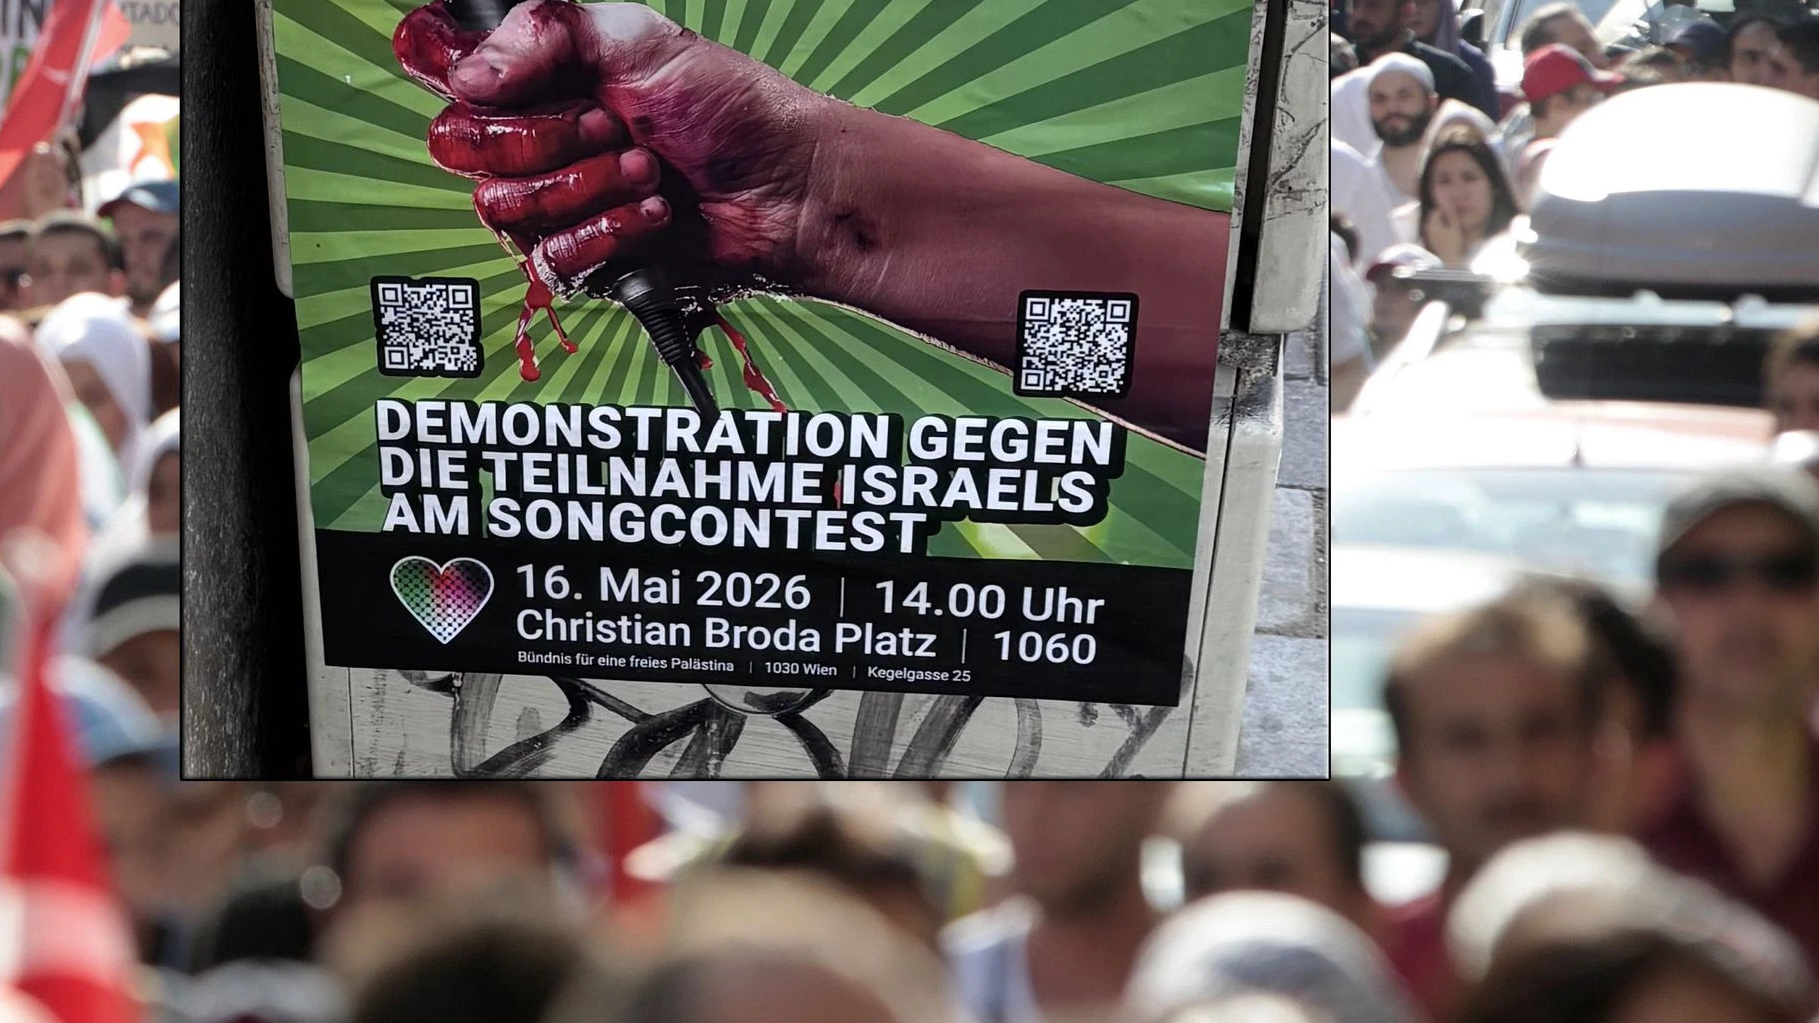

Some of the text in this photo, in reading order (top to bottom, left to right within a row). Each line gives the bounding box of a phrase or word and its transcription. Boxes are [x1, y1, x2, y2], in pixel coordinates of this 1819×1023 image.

[376, 400, 1113, 466] DEMONSTRATION GEGEN
[380, 447, 1097, 514] DIE TEILNAHME ISRAELS
[382, 493, 928, 555] AM SONGCONTEST
[516, 564, 1105, 625] 16. Mai 2026 14.00 Uhr
[515, 608, 1098, 665] Christian Broda Platz 1060
[518, 651, 971, 683] Bündnis für eine freies Palästina 1030 Wien Kegelgasse 25
